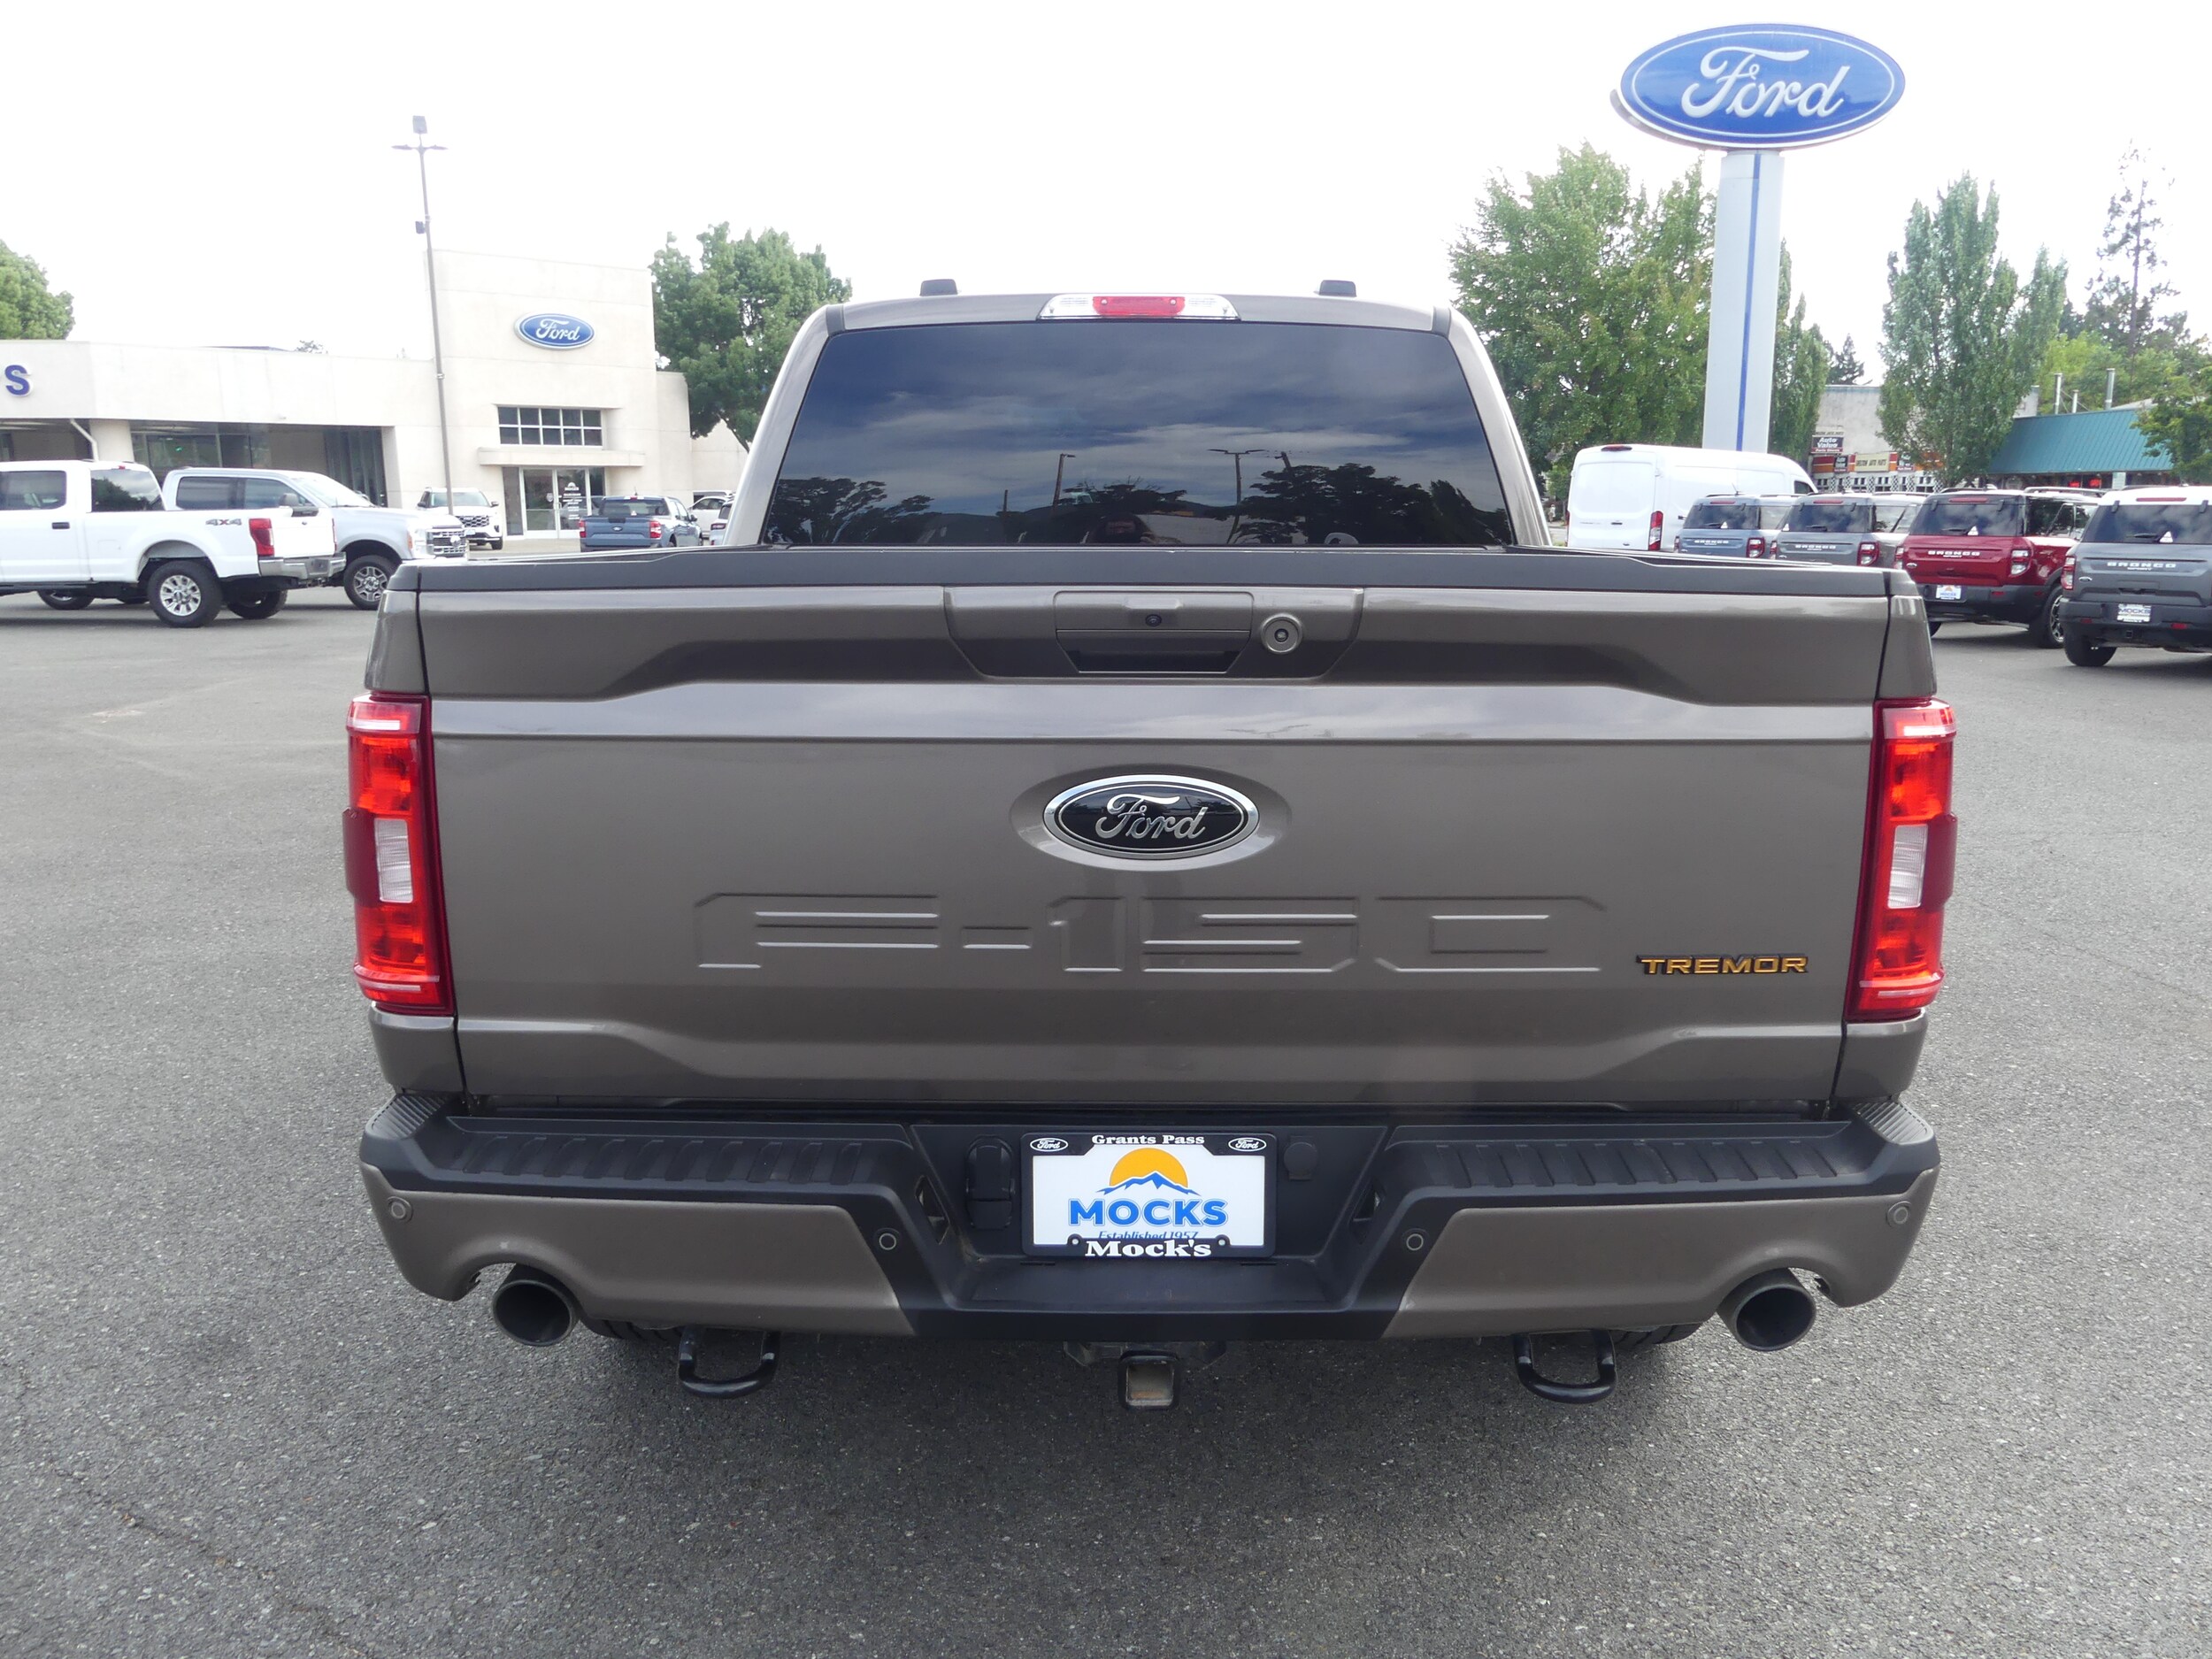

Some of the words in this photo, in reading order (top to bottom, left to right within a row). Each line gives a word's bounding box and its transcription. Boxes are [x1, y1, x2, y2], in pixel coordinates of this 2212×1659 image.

[1681, 46, 1850, 118] Ford
[536, 318, 580, 342] Ford
[1095, 794, 1208, 839] Ford
[694, 892, 1607, 973] F-150
[1636, 954, 1809, 974] TREMOR
[1037, 1138, 1061, 1149] Ford
[1092, 1134, 1156, 1145] Grants
[1162, 1134, 1205, 1145] Pass
[1235, 1138, 1259, 1149] Ford
[1069, 1199, 1228, 1226] MOCKS
[1085, 1239, 1212, 1257] Mock's
